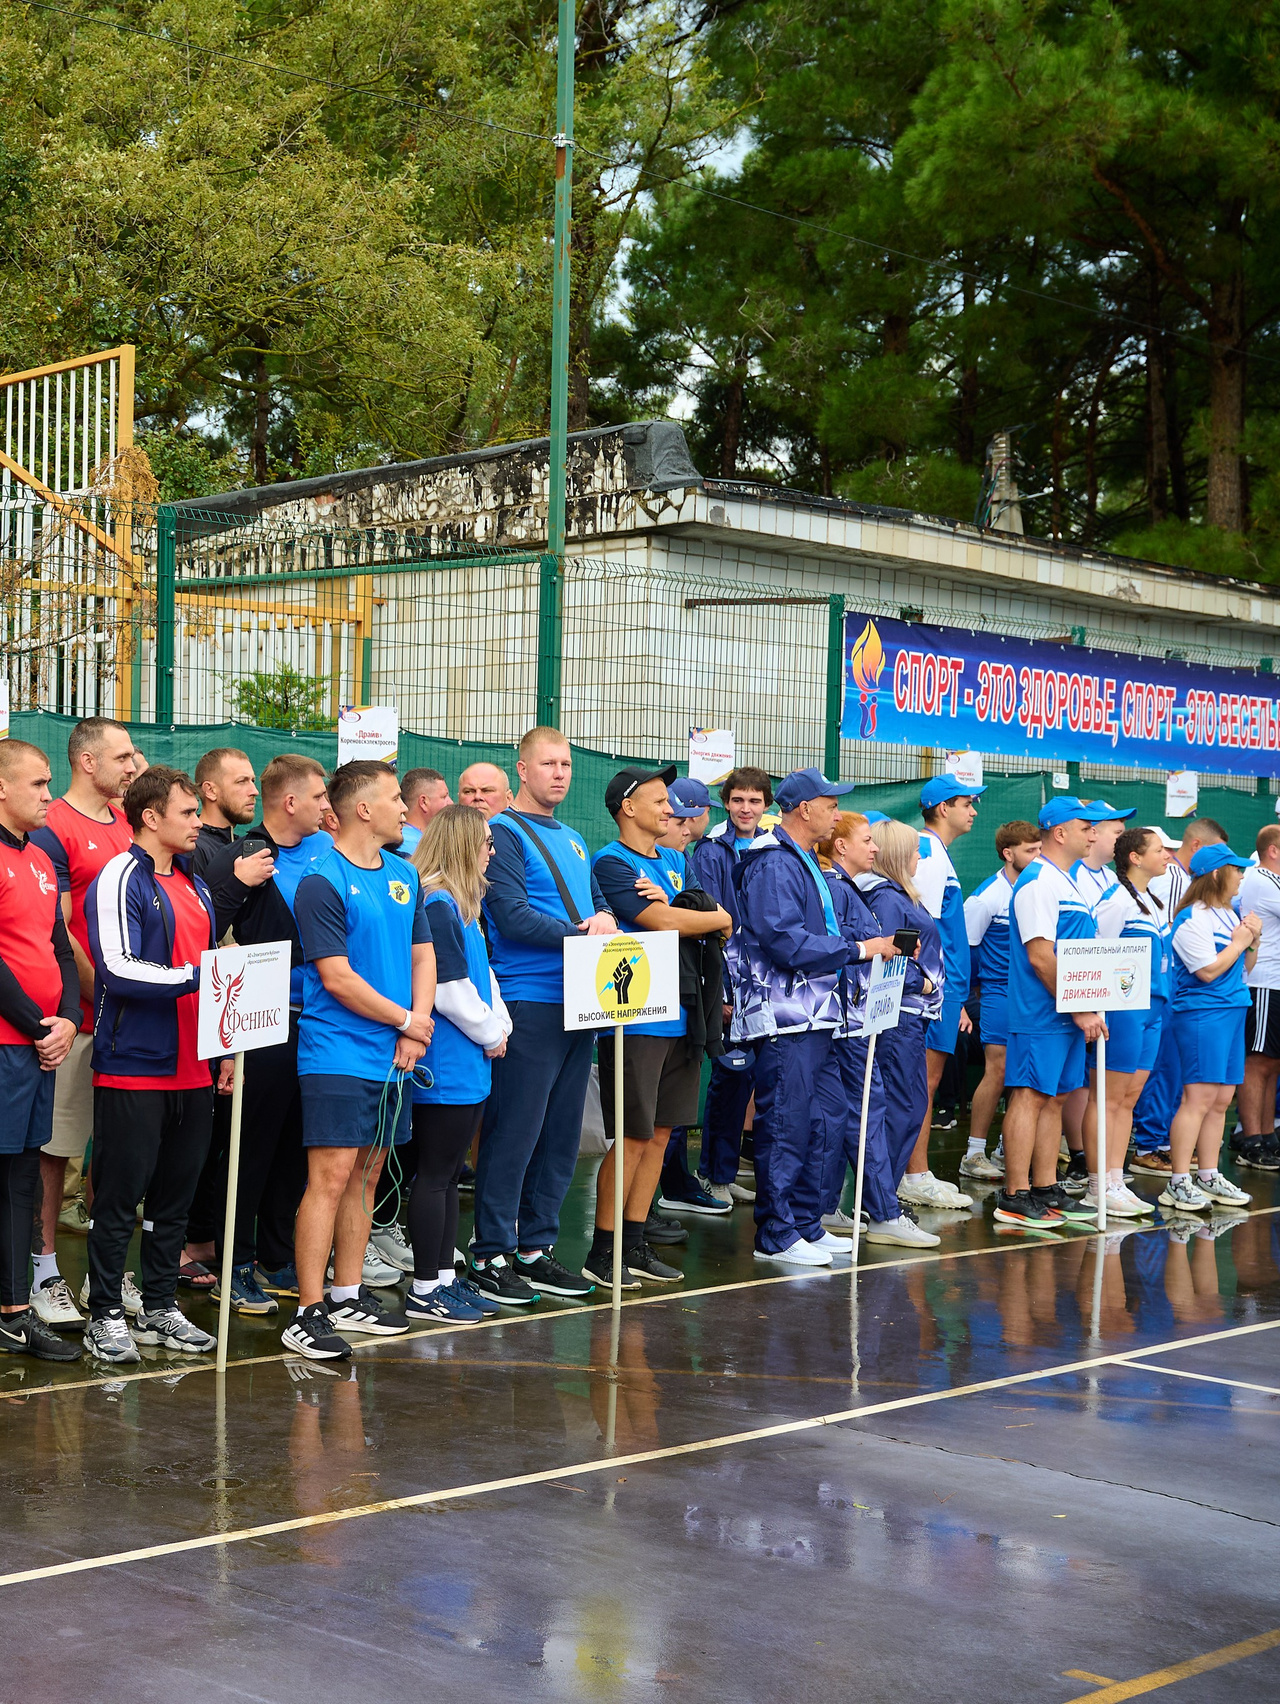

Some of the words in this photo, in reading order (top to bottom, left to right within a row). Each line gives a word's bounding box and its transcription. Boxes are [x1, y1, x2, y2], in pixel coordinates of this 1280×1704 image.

[894, 649, 964, 718] СПОРТ
[975, 661, 1016, 724] ЭТО
[1018, 666, 1119, 748] ЗДОРОВЬЕ,
[1122, 680, 1177, 741] СПОРТ
[1186, 688, 1216, 746] ЭТО
[355, 730, 382, 739] «Драйв»
[1063, 944, 1121, 955] ИСПОЛНИТЕЛЬНЫЙ
[1122, 945, 1147, 954] АППАРАТ
[883, 956, 907, 979] DRIVE
[1063, 970, 1102, 982] «ЭНЕРГИЯ
[1062, 988, 1111, 1001] ДВИЖЕНИЯ»
[578, 1010, 615, 1022] ВЫСОКИЕ
[616, 1005, 667, 1018] НАПРЯЖЕНИЯ
[870, 994, 895, 1023] «ДРАЙВ»
[228, 1007, 281, 1034] Феникс
